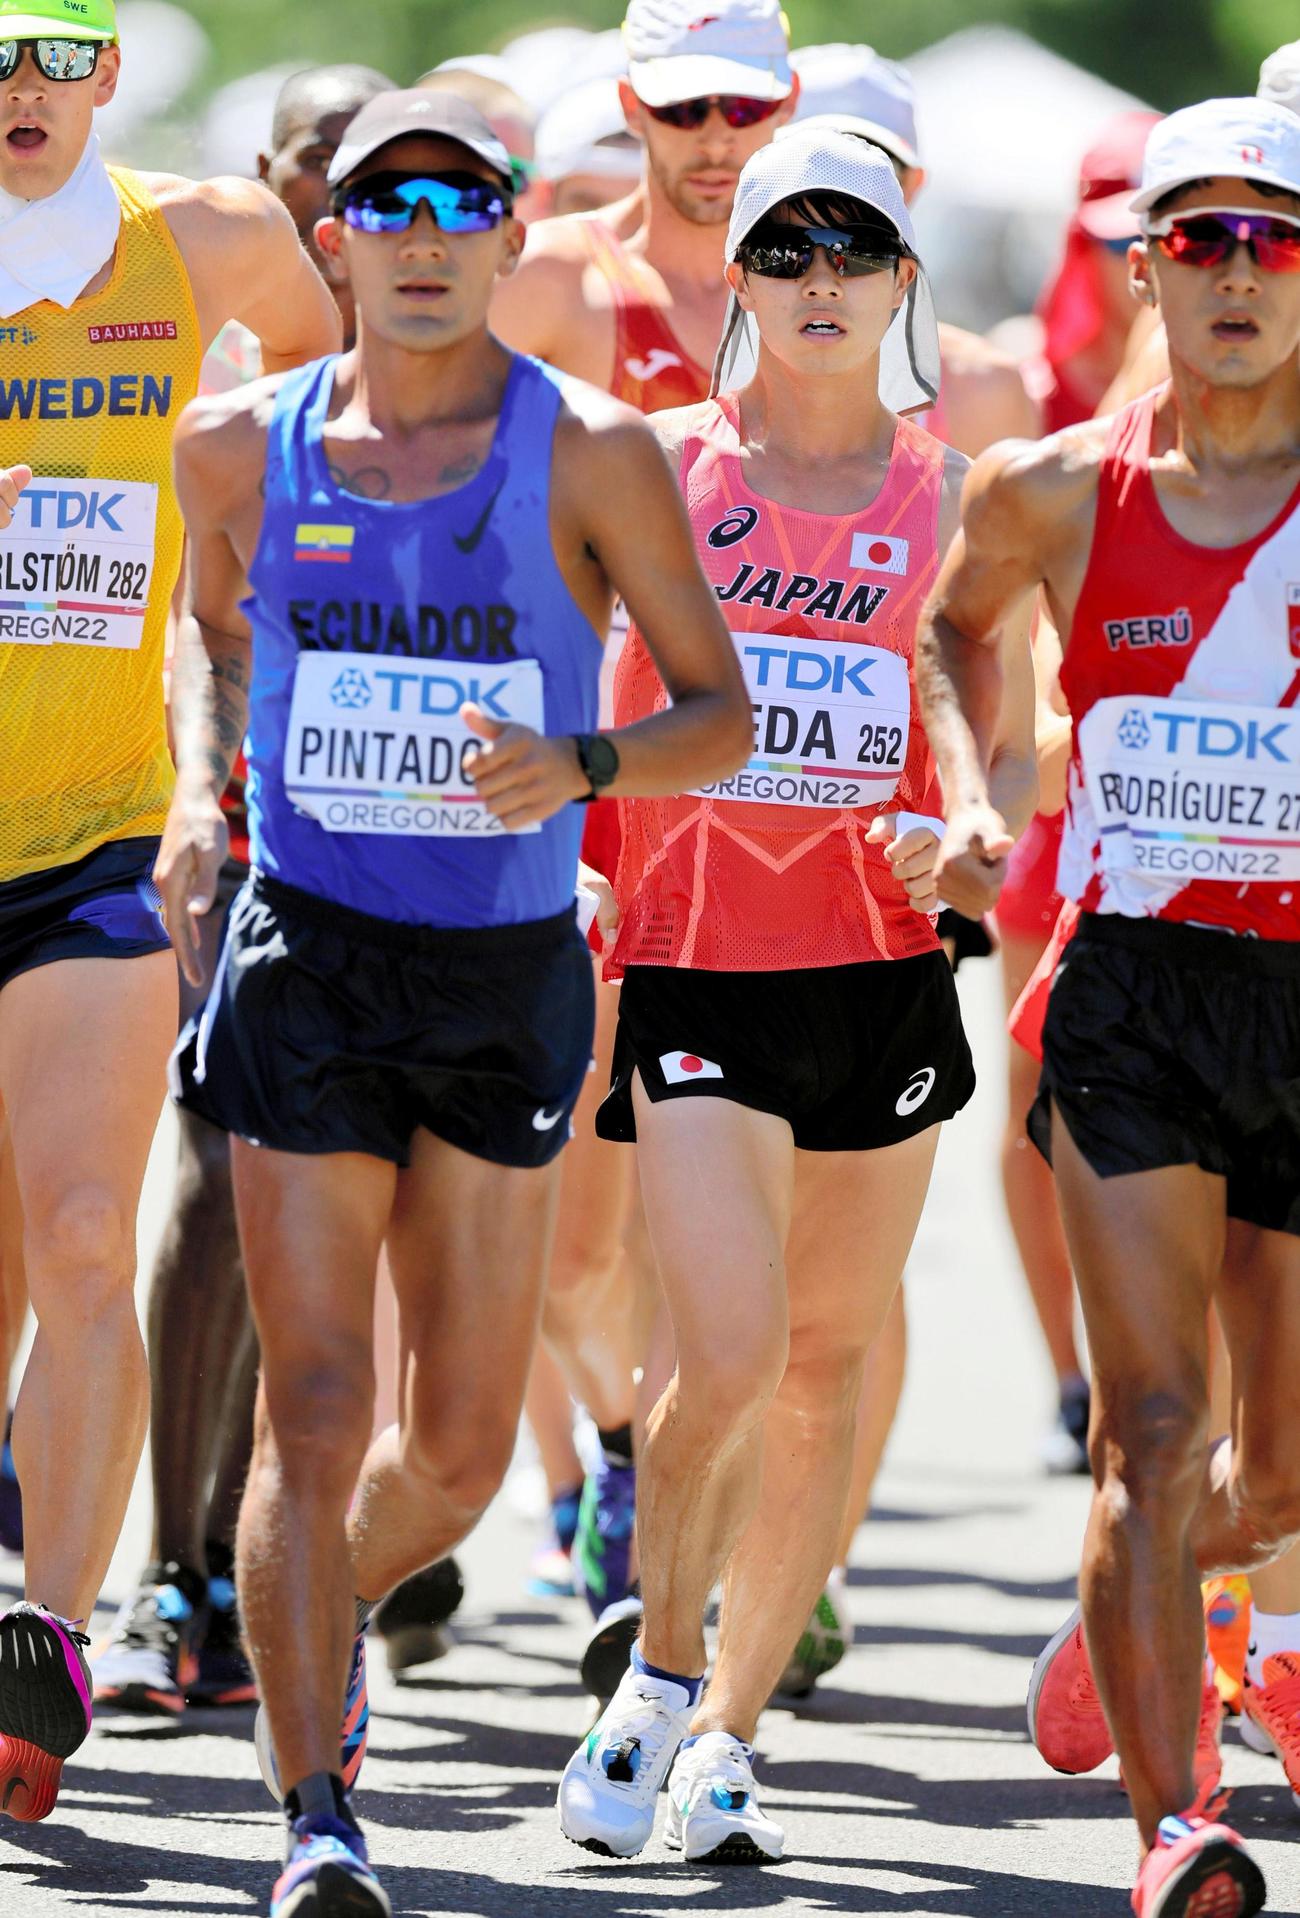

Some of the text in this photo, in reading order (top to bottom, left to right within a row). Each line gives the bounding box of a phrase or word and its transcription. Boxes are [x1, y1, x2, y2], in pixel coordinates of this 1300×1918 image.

[63, 0, 88, 13] SWE
[89, 322, 176, 342] BAUHAUS
[19, 490, 127, 532] TDK
[106, 561, 147, 601] 282
[714, 563, 889, 625] JAPAN
[289, 600, 517, 657] ECUADOR
[1105, 609, 1191, 650] PERÚ
[744, 647, 878, 696] TDK
[374, 671, 512, 718] TDK
[857, 724, 902, 765] 252
[1153, 712, 1291, 762] TDK
